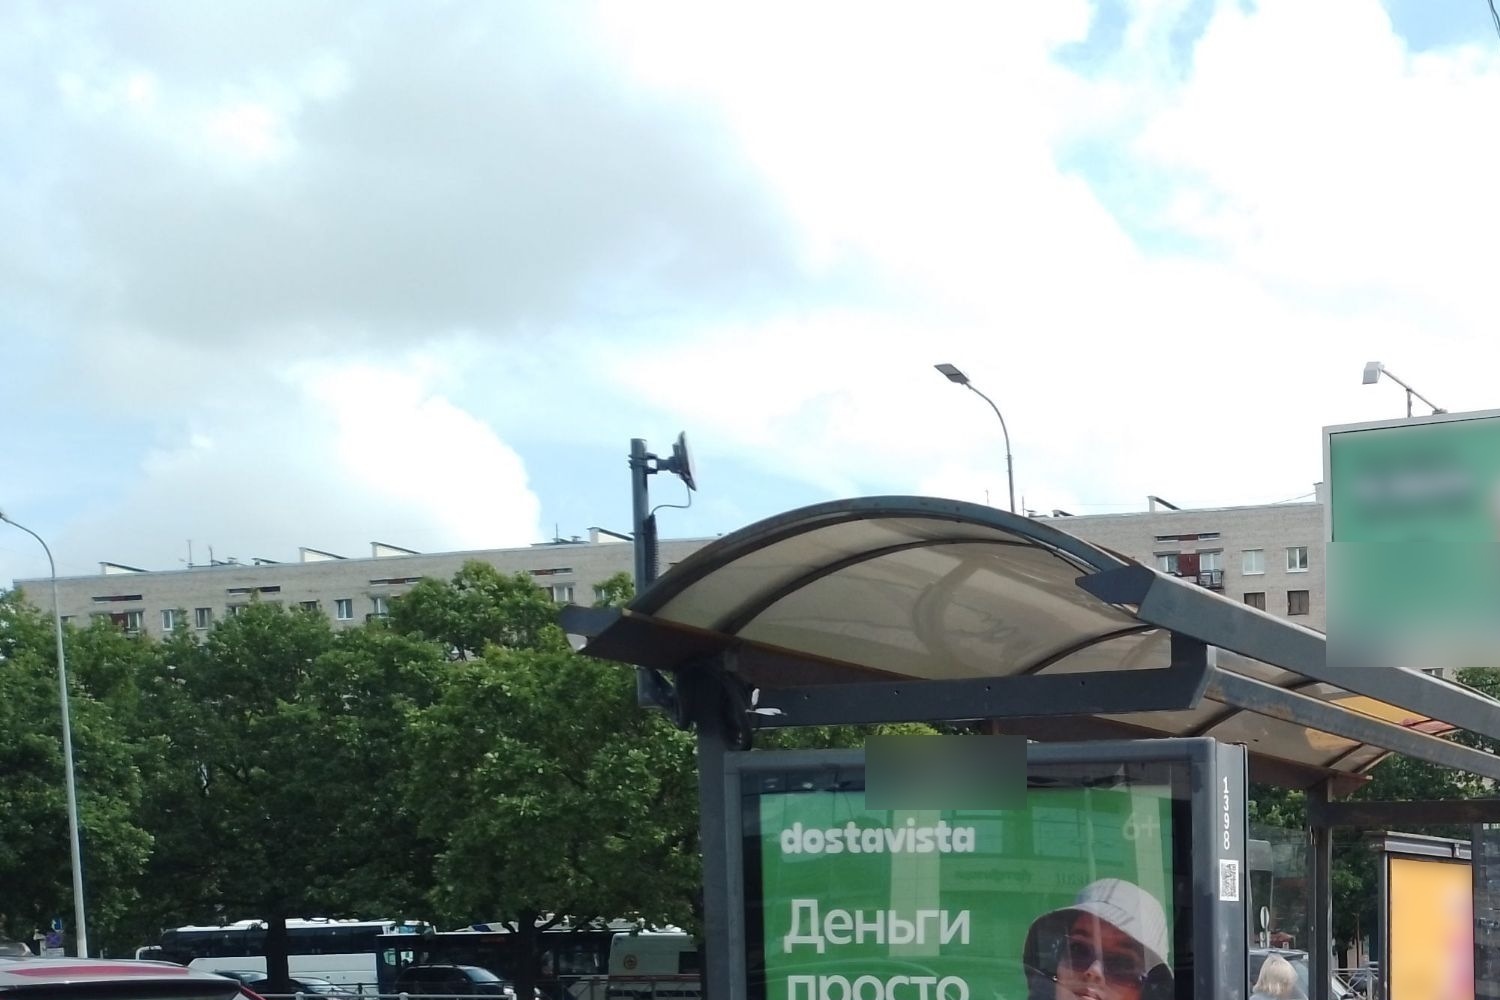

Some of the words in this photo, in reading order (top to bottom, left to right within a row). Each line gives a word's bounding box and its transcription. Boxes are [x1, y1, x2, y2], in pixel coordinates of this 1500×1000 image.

[780, 818, 976, 855] dostavista
[1122, 812, 1160, 840] 6+
[1222, 776, 1231, 851] 1398
[783, 898, 971, 954] Деньги
